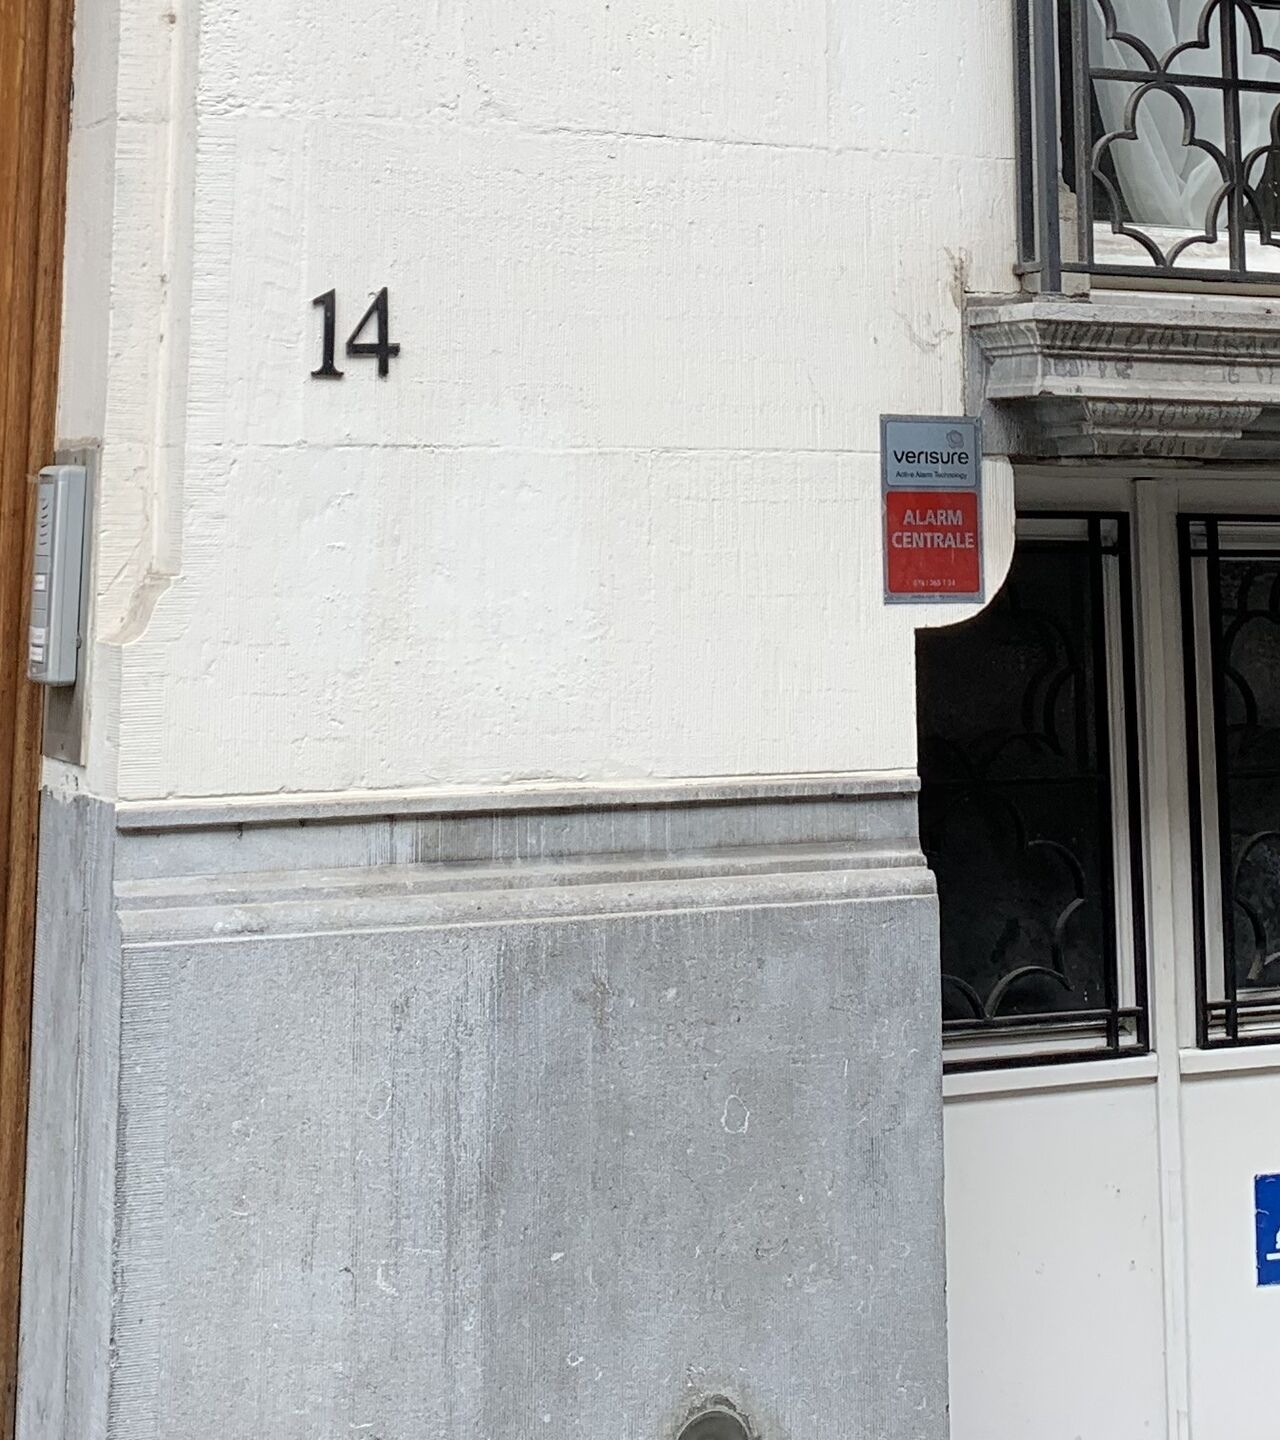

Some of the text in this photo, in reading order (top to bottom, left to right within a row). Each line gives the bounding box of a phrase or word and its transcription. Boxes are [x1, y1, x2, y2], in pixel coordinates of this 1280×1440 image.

[310, 286, 401, 380] 14
[893, 449, 970, 465] verisure
[895, 470, 968, 480] Active Alarm Technology
[903, 509, 963, 526] ALARM
[891, 532, 975, 549] CENTRALE
